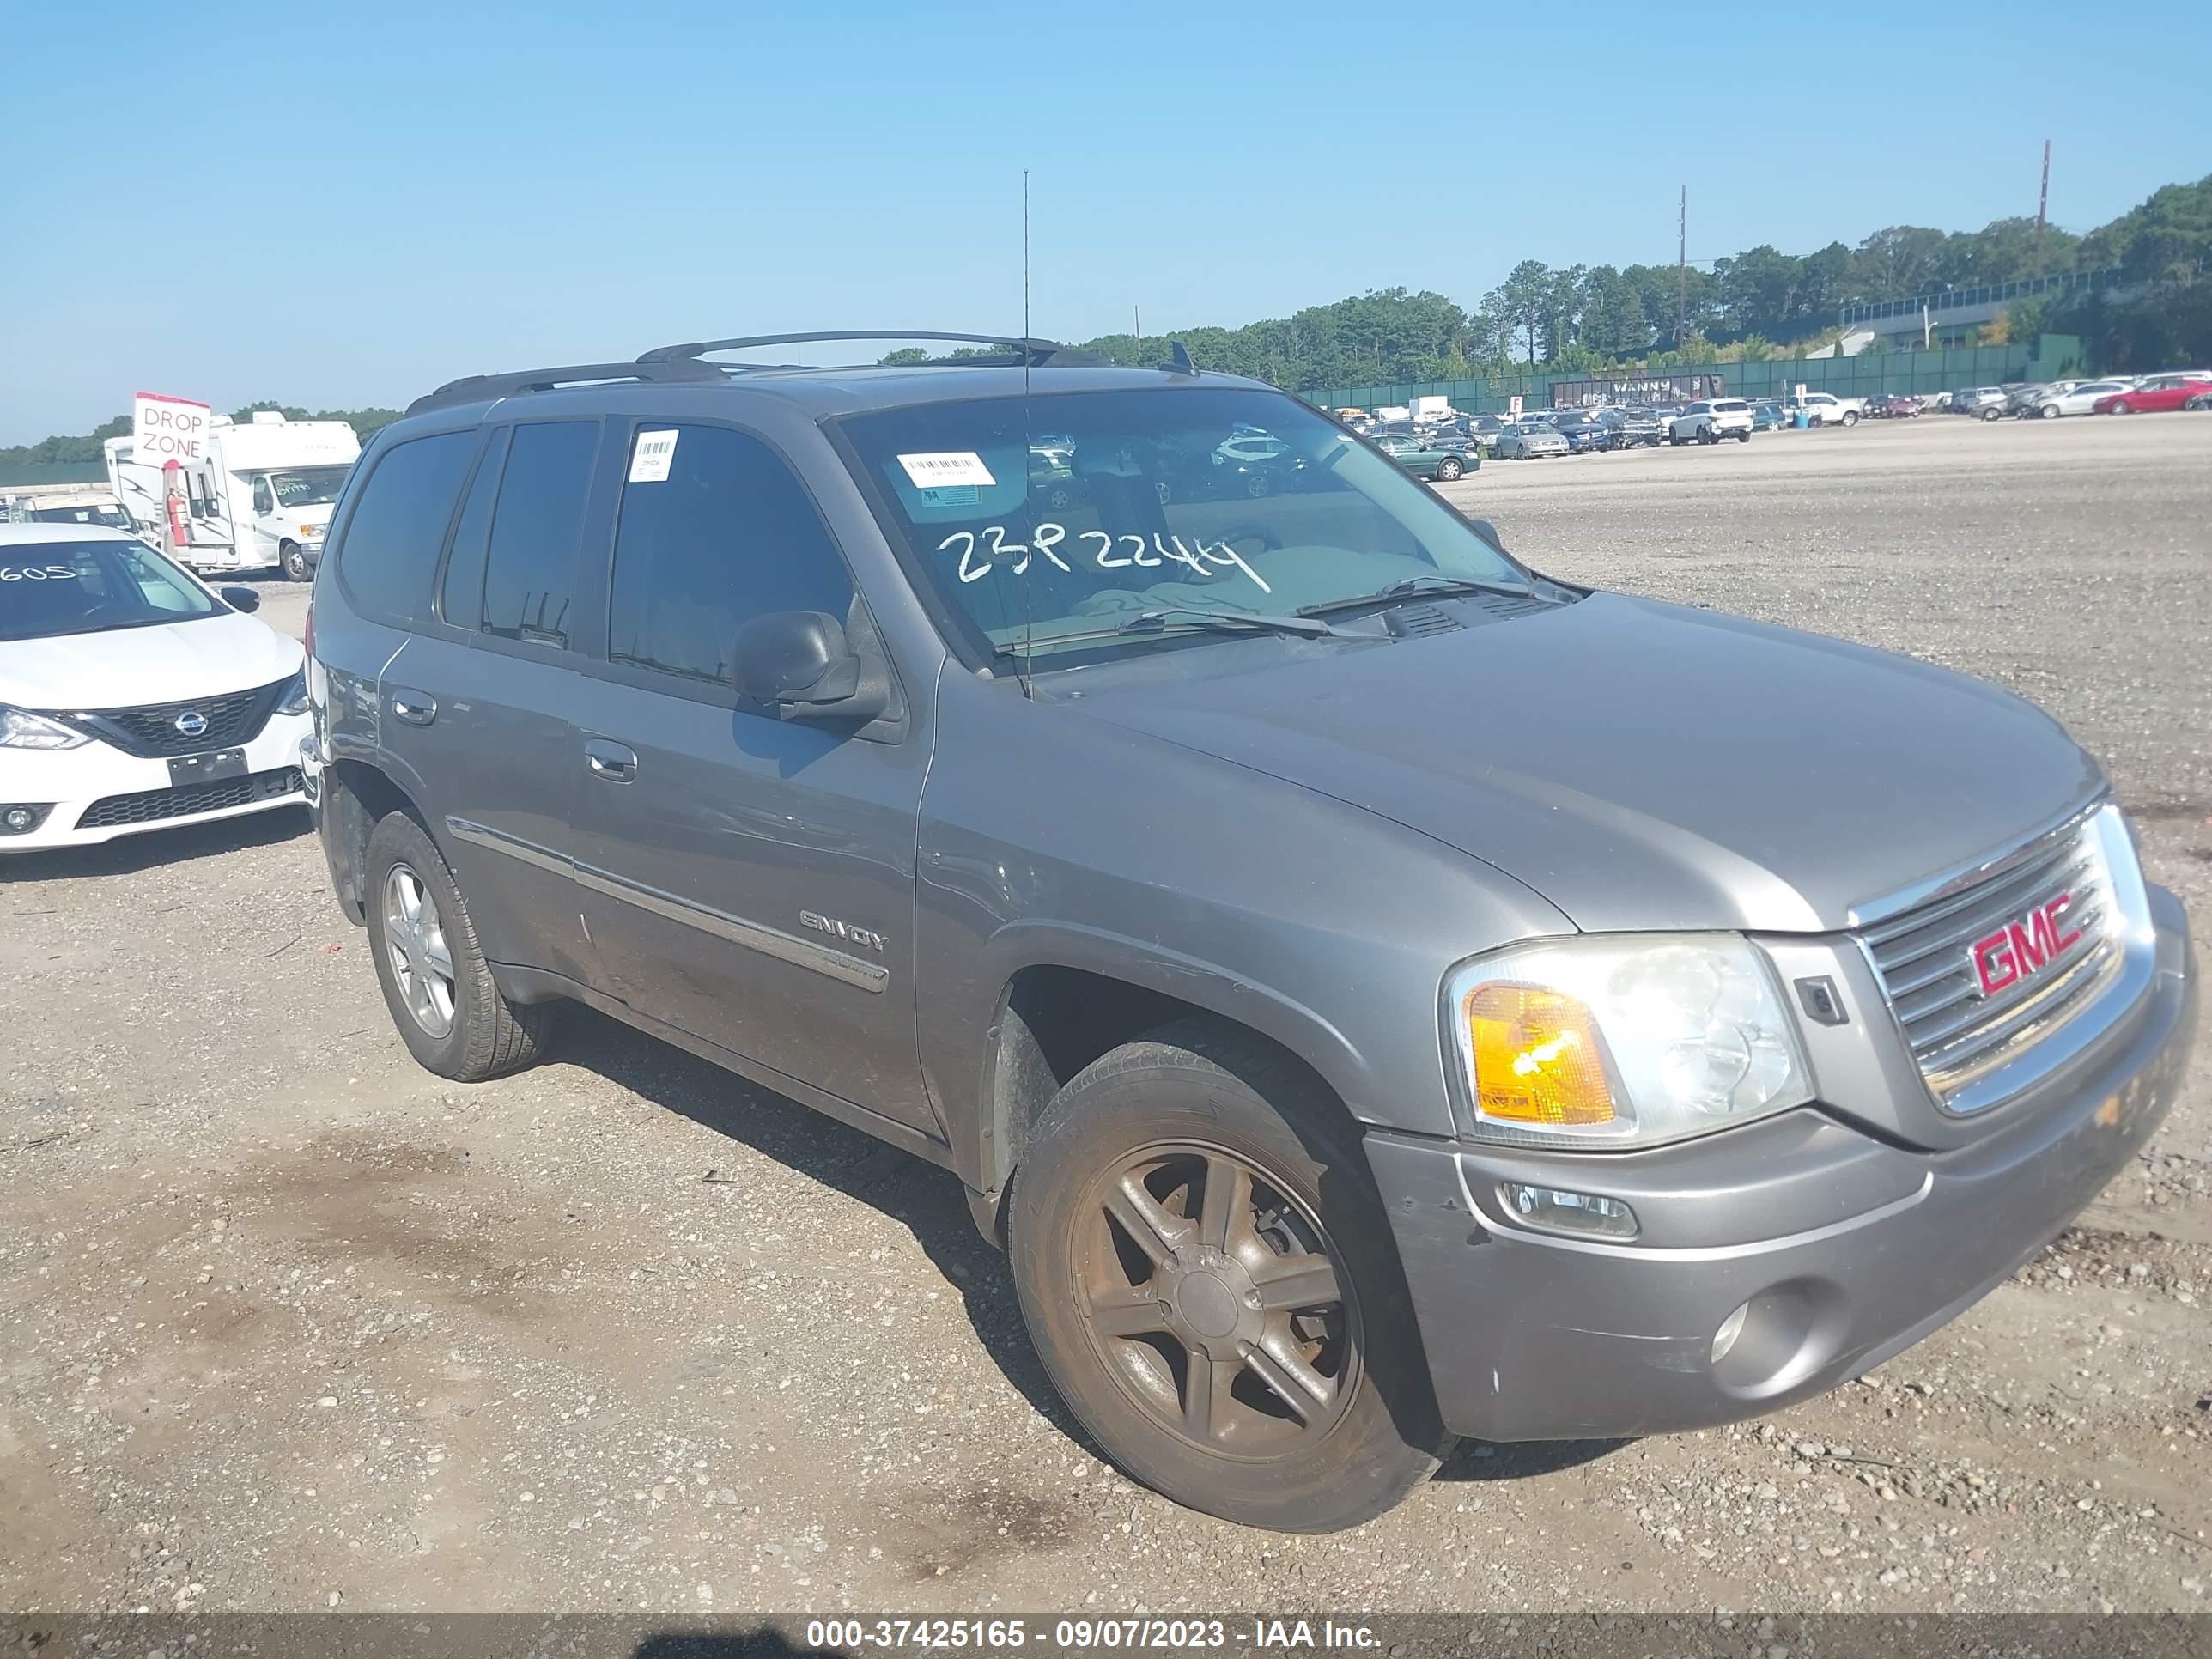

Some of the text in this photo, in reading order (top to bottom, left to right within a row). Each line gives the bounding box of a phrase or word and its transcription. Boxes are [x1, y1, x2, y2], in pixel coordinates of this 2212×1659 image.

[144, 408, 202, 433] DROP
[143, 432, 200, 459] ZONE
[800, 910, 890, 952] ENVOY
[1968, 891, 2082, 997] GMC
